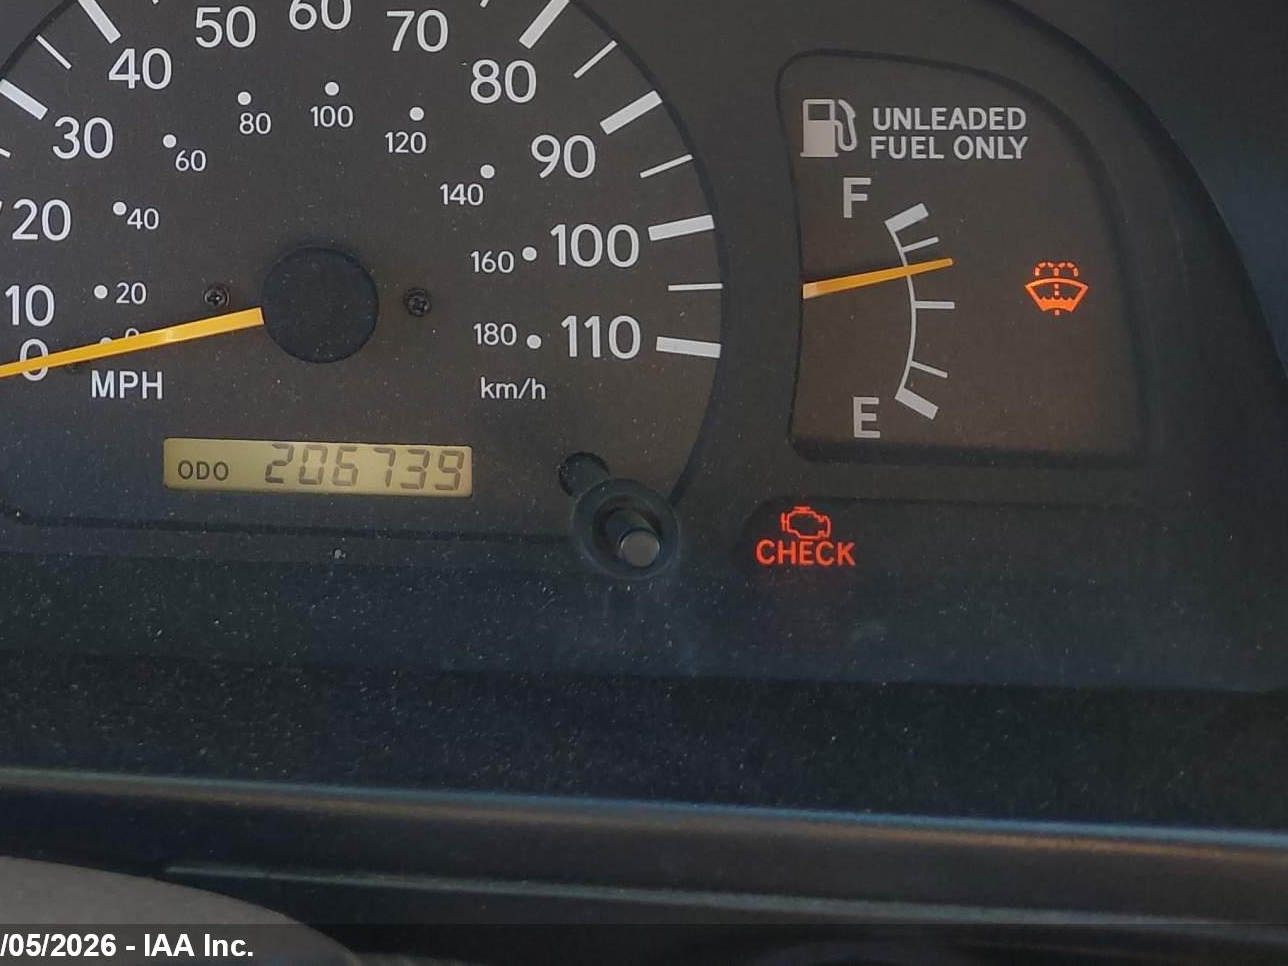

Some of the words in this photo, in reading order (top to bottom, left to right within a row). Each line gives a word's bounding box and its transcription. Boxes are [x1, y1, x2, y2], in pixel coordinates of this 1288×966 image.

[195, 5, 256, 48] 50
[387, 9, 449, 52] 70
[108, 47, 172, 89] 40
[471, 59, 537, 104] 80
[239, 113, 271, 135] 80
[311, 105, 353, 128] 100
[873, 107, 1026, 131] UNLEADED
[53, 116, 113, 159] 30
[385, 132, 426, 154] 120
[871, 136, 944, 159] FUEL
[954, 136, 1028, 160] ONLY
[176, 150, 206, 172] 60
[531, 134, 595, 179] 90
[440, 183, 483, 205] 140
[842, 177, 871, 218] F
[12, 198, 71, 241] 20
[127, 208, 159, 230] 40
[551, 223, 639, 268] 100
[471, 250, 514, 273] 160
[6, 284, 54, 327] 10
[117, 282, 146, 304] 20
[474, 323, 517, 346] 180
[562, 315, 641, 359] 110
[91, 370, 163, 399] MPH
[481, 377, 546, 401] km/h
[854, 397, 880, 438] E
[178, 461, 229, 481] ODO
[264, 444, 465, 491] 206739
[756, 541, 855, 566] CHECK
